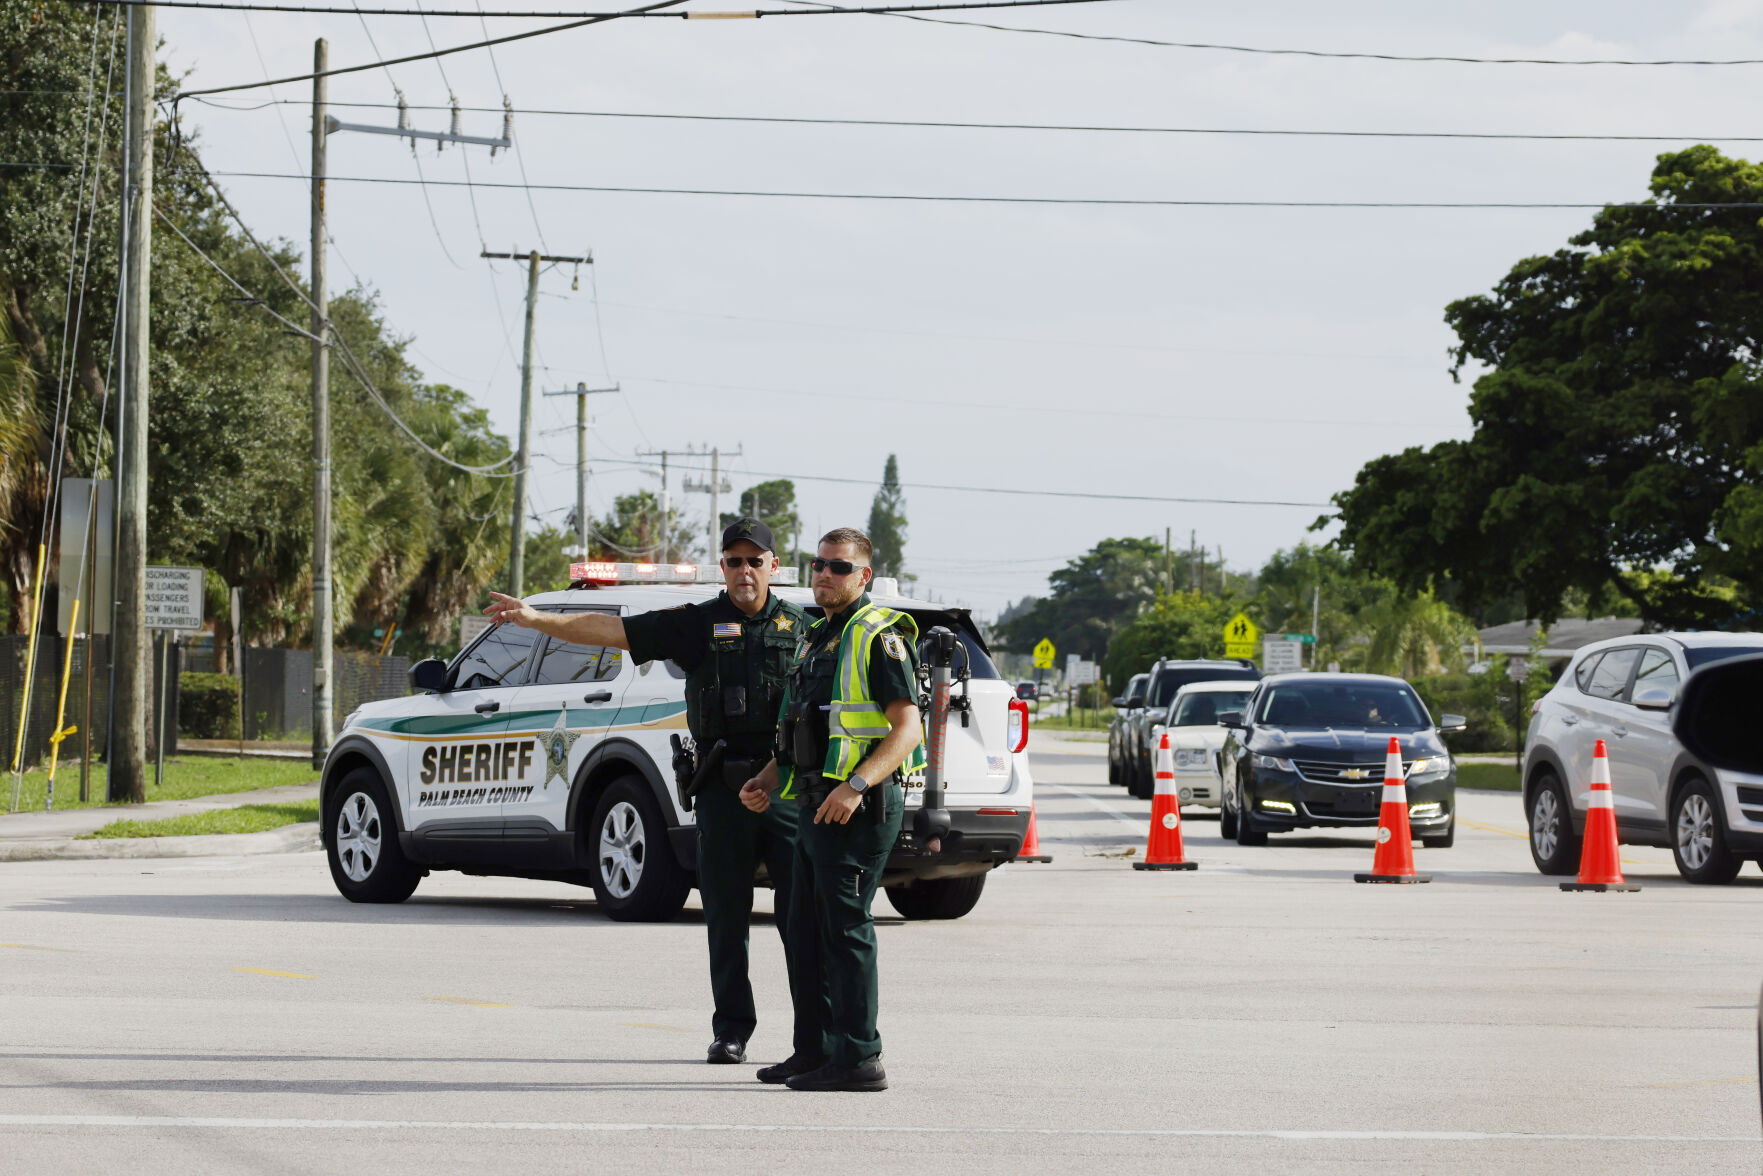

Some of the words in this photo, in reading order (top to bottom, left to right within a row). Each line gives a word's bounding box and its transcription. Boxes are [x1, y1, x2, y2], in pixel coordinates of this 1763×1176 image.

[146, 571, 190, 580] ISCHARGING
[156, 582, 189, 591] LOADING
[145, 593, 190, 602] ASSENGERS
[163, 605, 191, 614] TRAVEL
[157, 616, 199, 626] PROHIBITED
[420, 741, 535, 785] SHERIFF
[418, 791, 450, 808] PALM
[449, 788, 486, 806] BEACH
[486, 785, 535, 804] COUNTY
